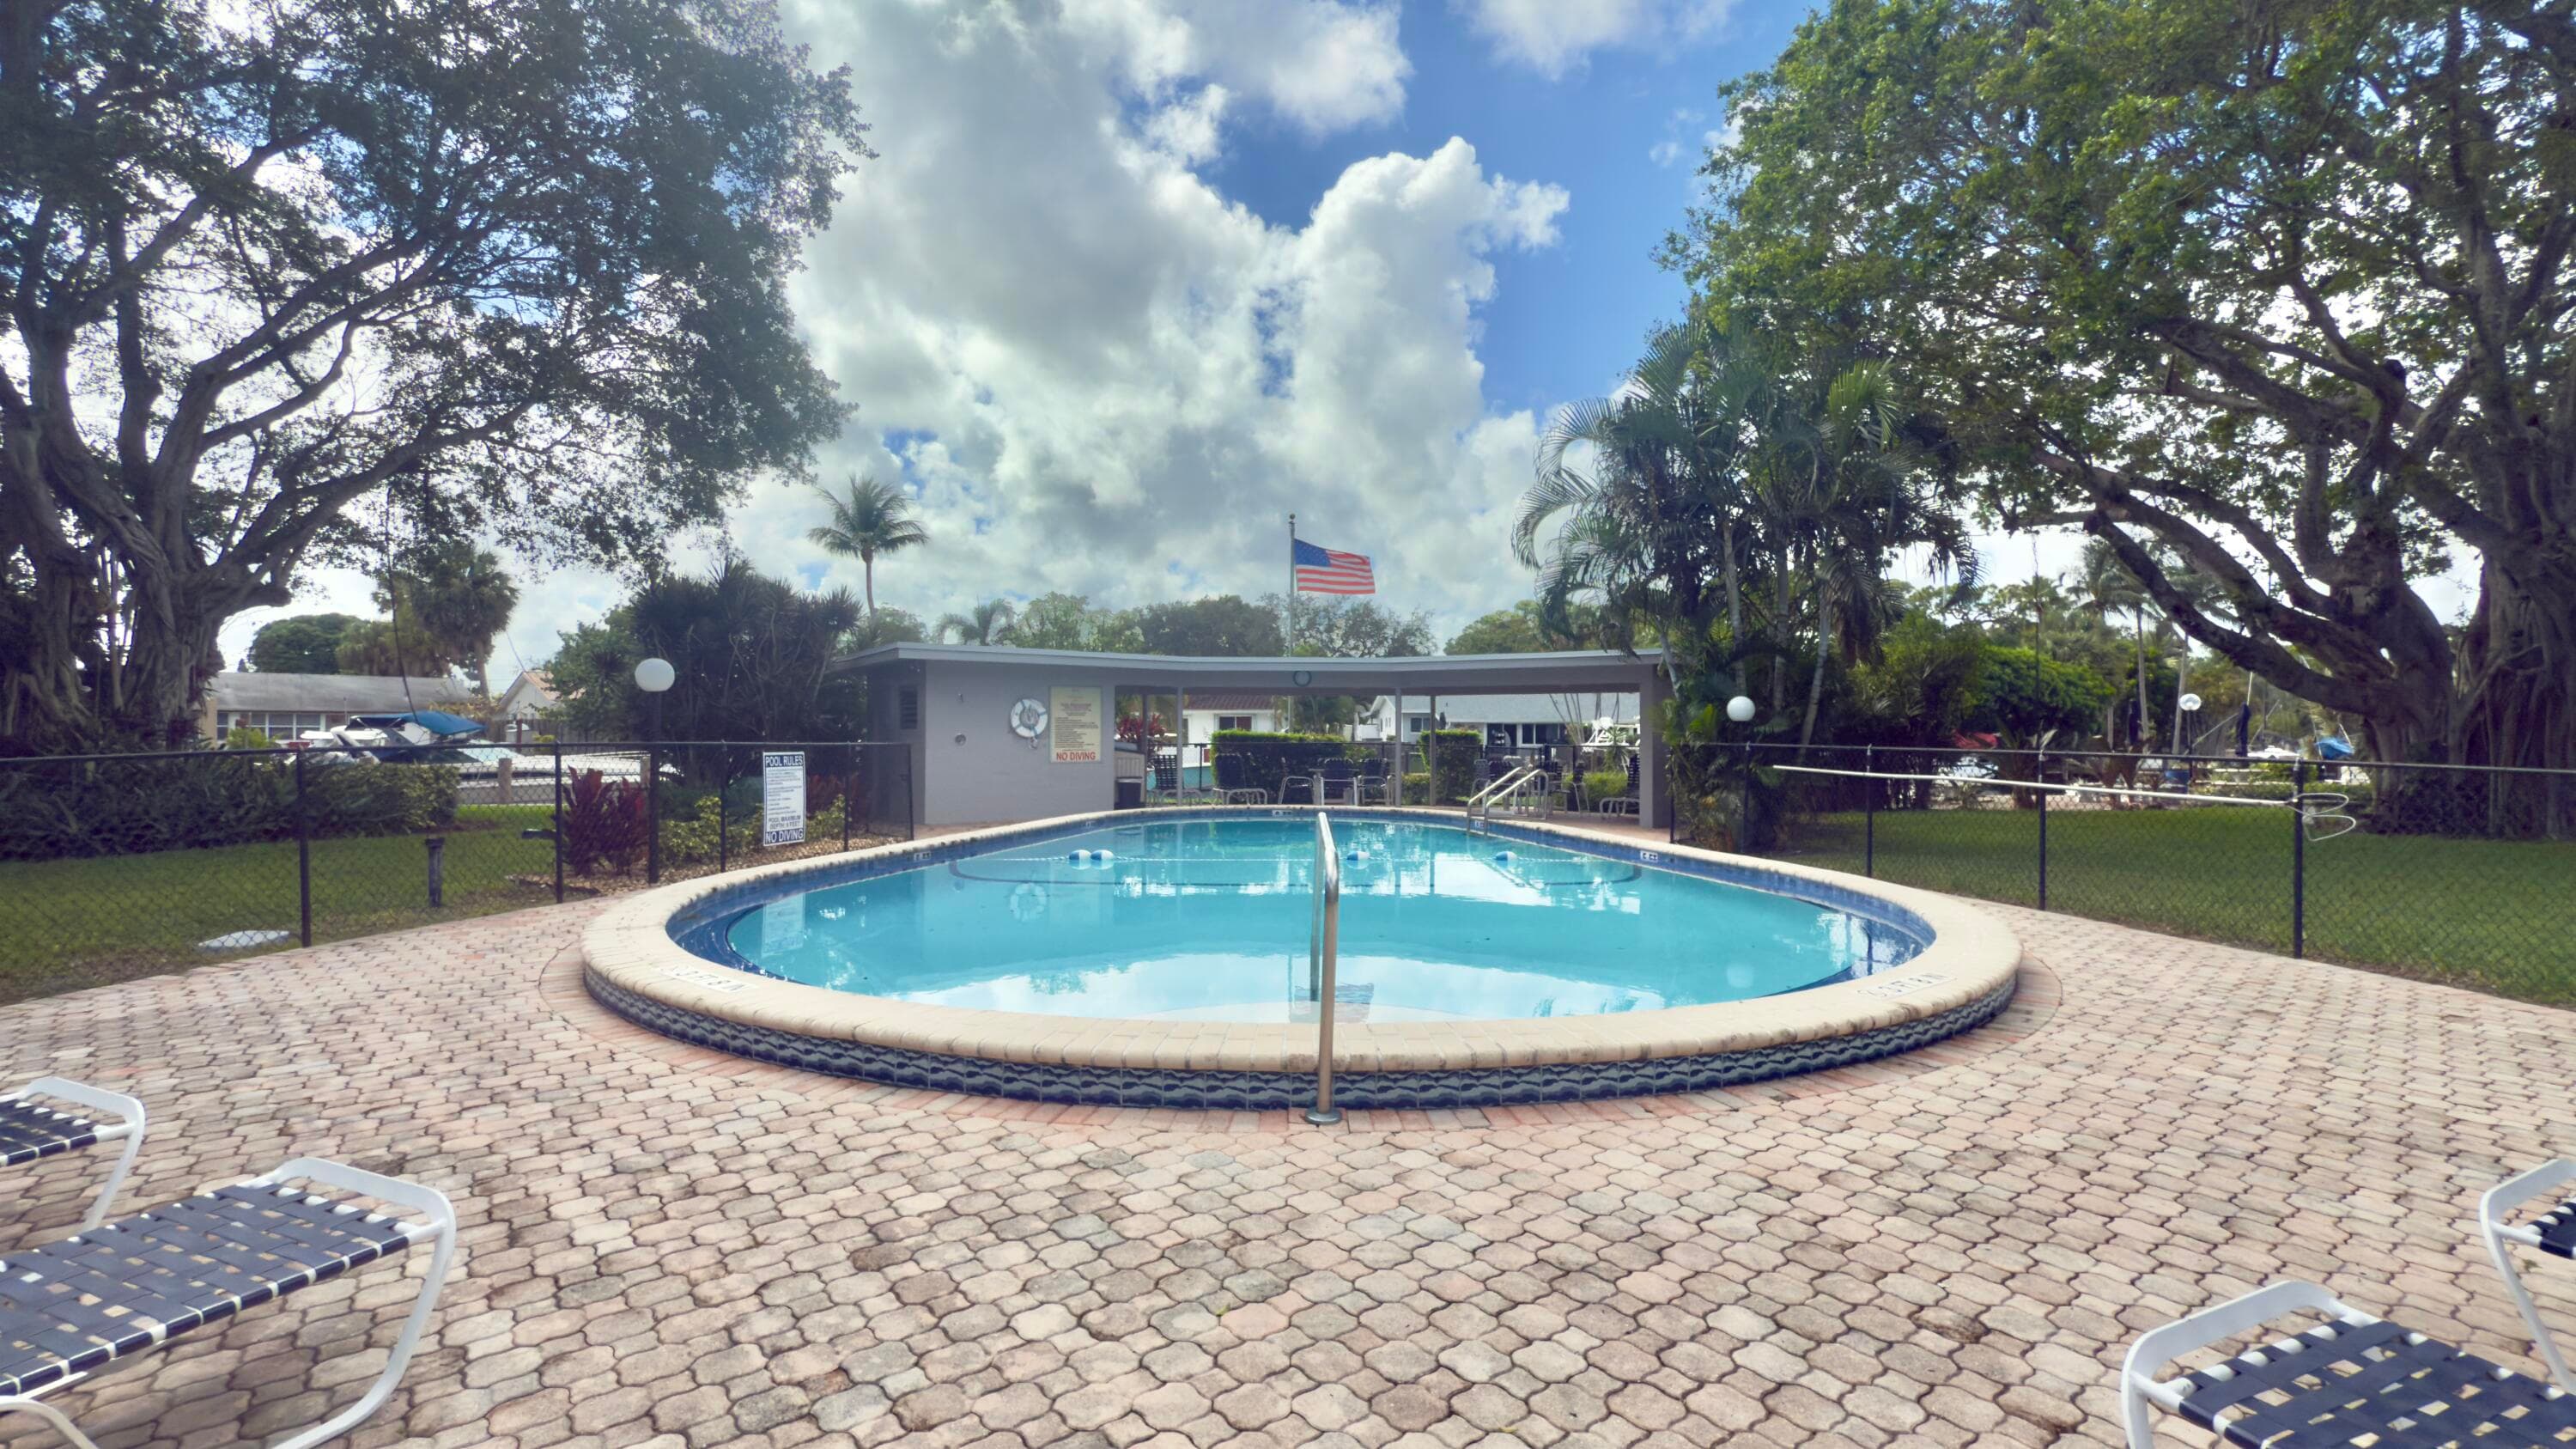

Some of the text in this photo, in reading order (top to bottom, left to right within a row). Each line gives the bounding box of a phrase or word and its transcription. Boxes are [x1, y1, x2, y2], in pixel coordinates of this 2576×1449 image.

[766, 756, 803, 767] POOL RULES
[1056, 752, 1096, 760] NO DIVING
[766, 829, 804, 843] NO DIVING
